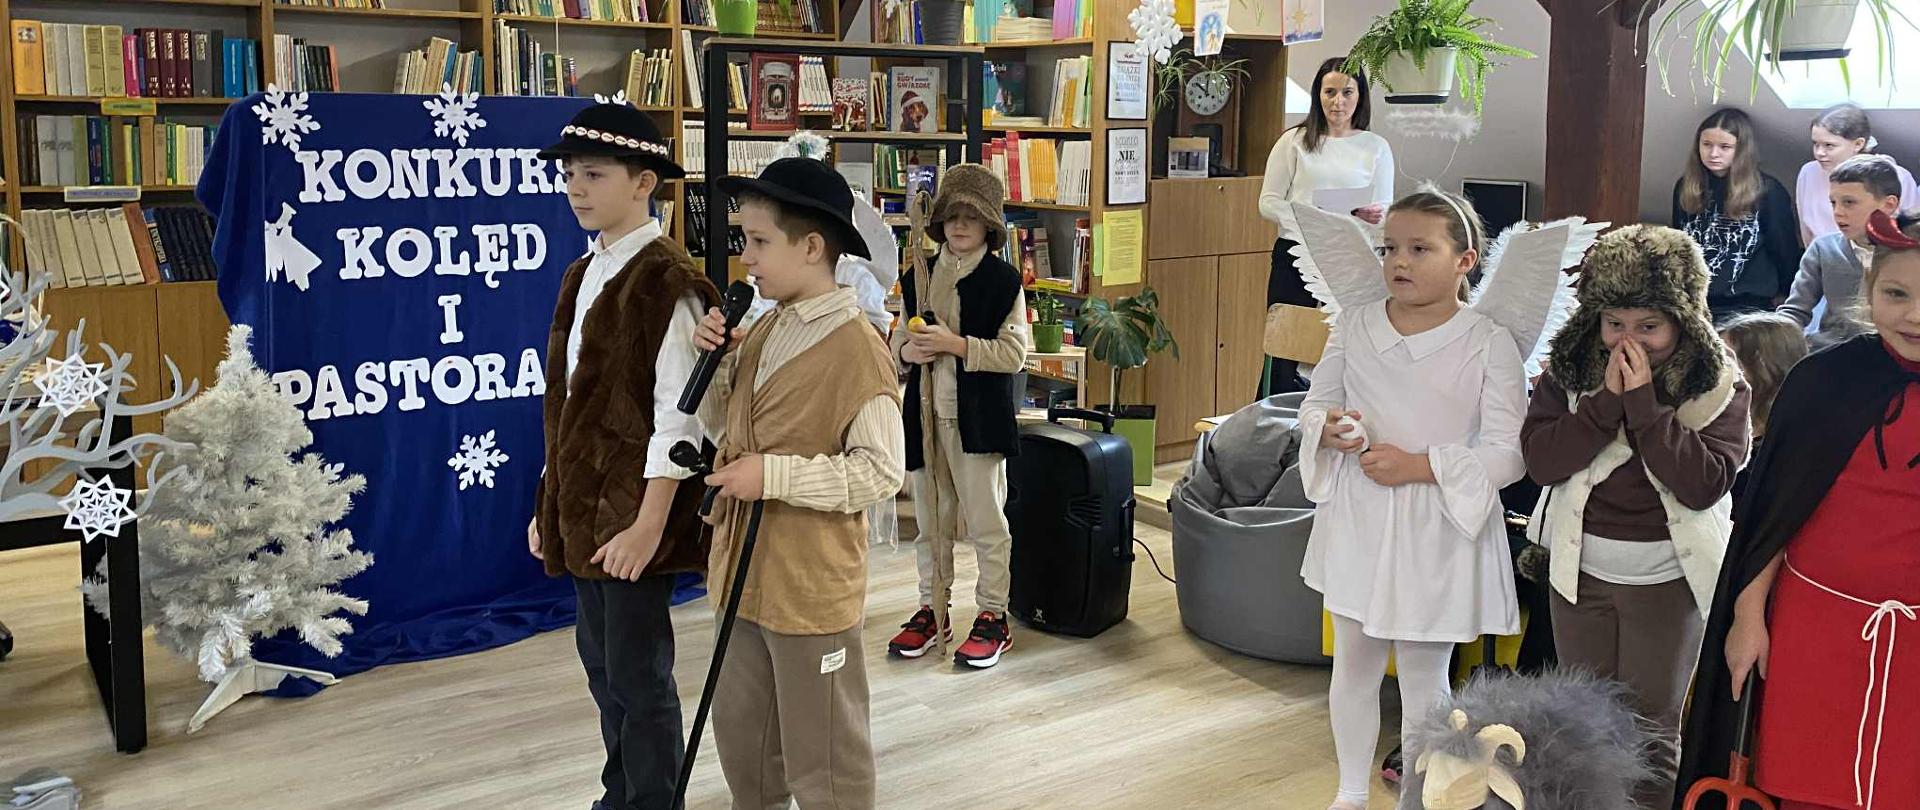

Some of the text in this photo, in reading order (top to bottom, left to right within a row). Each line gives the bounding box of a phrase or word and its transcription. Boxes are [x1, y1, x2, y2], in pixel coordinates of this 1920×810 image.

[1118, 150, 1135, 161] NIE
[337, 223, 546, 289] KOLĘD
[437, 294, 464, 345] I
